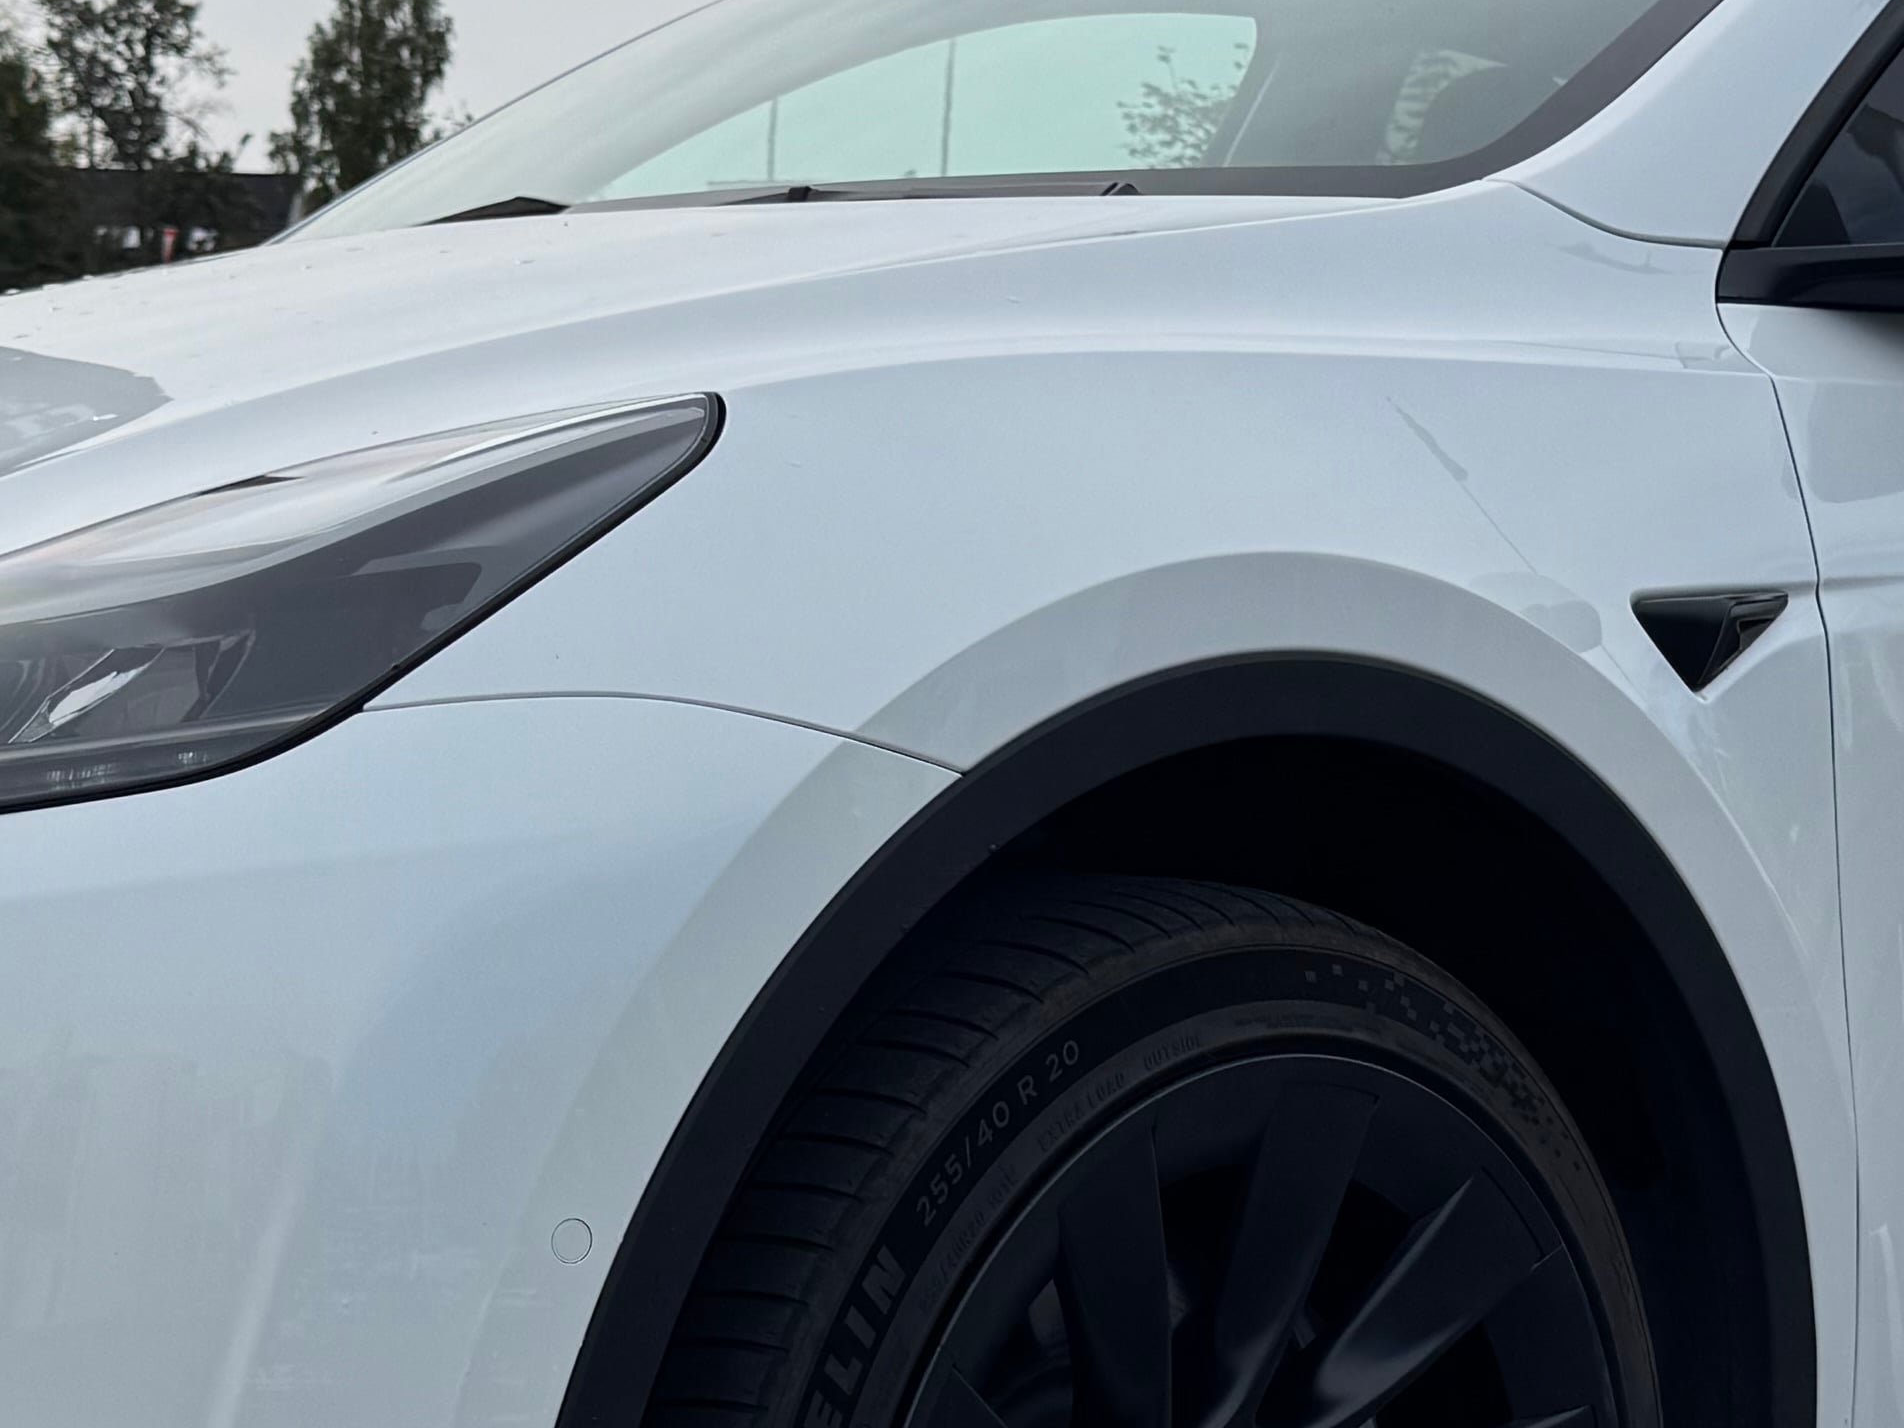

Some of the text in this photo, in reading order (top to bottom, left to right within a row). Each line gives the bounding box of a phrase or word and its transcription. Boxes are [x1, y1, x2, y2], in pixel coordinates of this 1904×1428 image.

[917, 1038, 1081, 1229] 255/40 R 20
